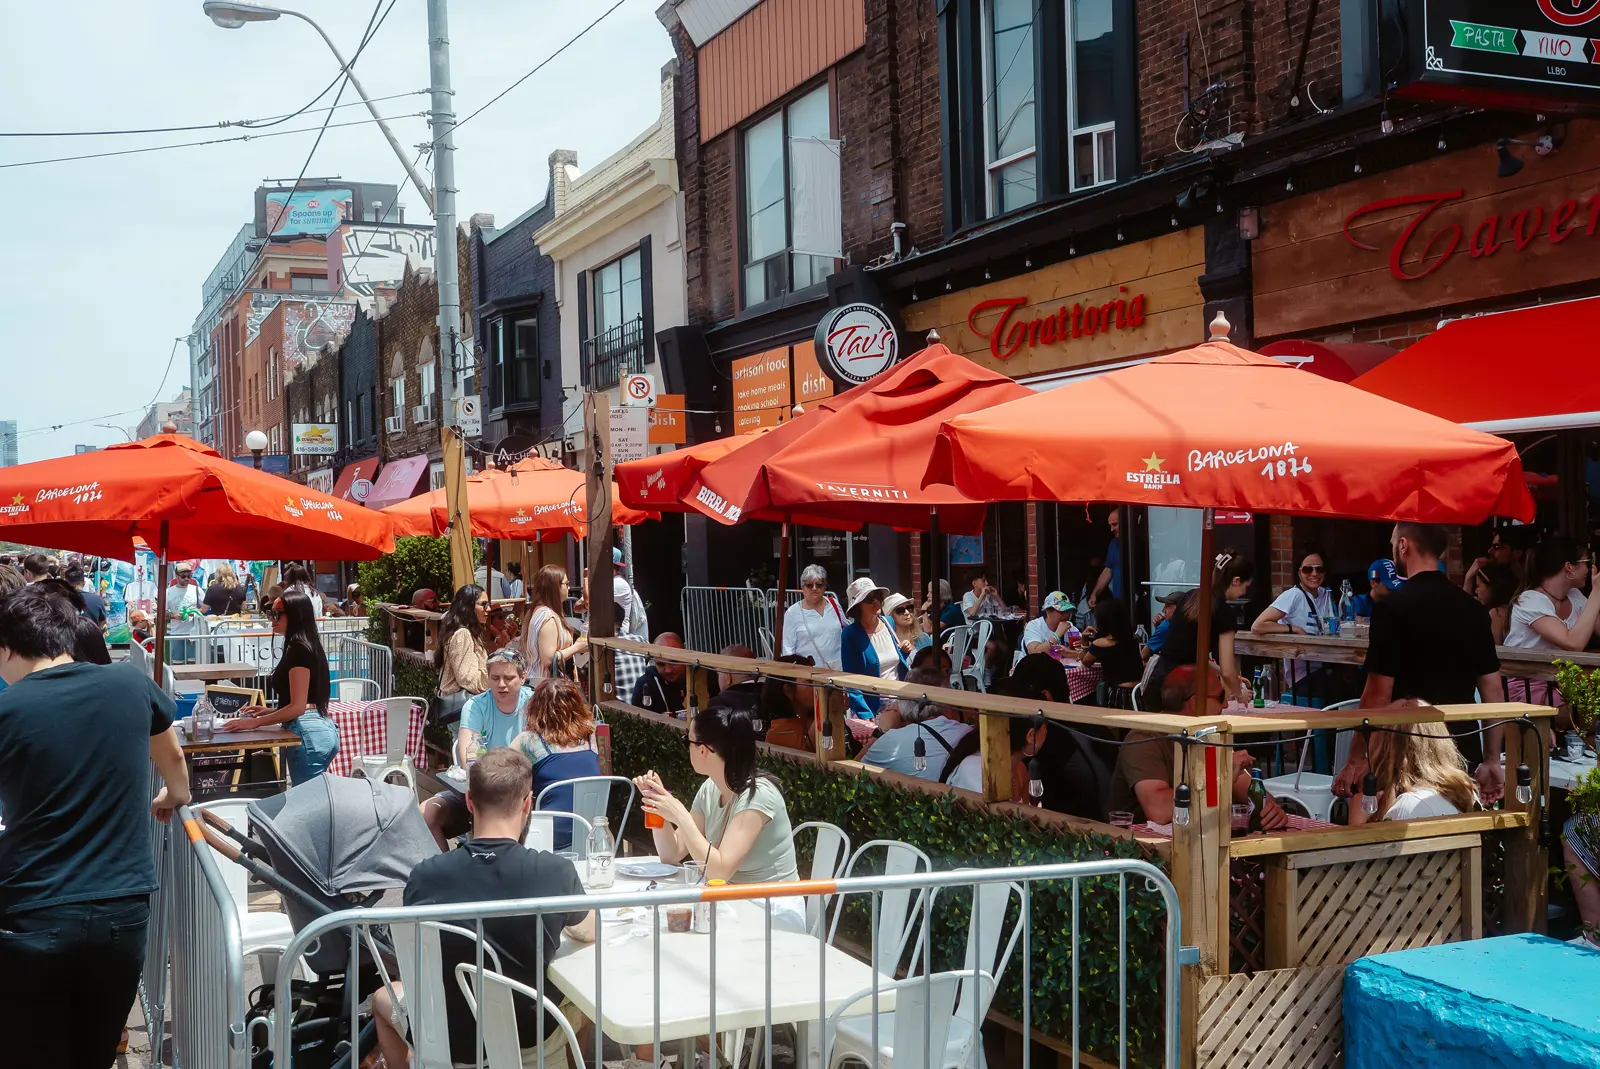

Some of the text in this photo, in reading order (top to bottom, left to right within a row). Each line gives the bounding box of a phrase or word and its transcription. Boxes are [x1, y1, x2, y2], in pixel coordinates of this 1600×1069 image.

[1462, 26, 1572, 56] PASTA VINO
[1546, 65, 1567, 76] LLBO
[290, 217, 334, 225] for summer
[292, 210, 333, 218] Spoons up
[843, 306, 878, 316] THE ORIGINAL
[968, 285, 1145, 360] Trattoria
[827, 325, 894, 359] Tav's
[734, 354, 788, 380] artisan food
[737, 380, 786, 400] take home meals
[802, 369, 826, 395] dish
[760, 395, 779, 409] school
[651, 412, 676, 426] dish
[1187, 441, 1300, 472] BARCELONA
[1261, 456, 1312, 480] 1876
[1126, 472, 1180, 484] ESTRELLA
[35, 481, 100, 503] BARCELONA
[73, 490, 103, 505] 1876
[815, 482, 908, 499] TAVERNITI
[534, 499, 576, 516] BARCELONA
[696, 485, 728, 515] BIRRA
[0, 505, 30, 514] ESTRELLA
